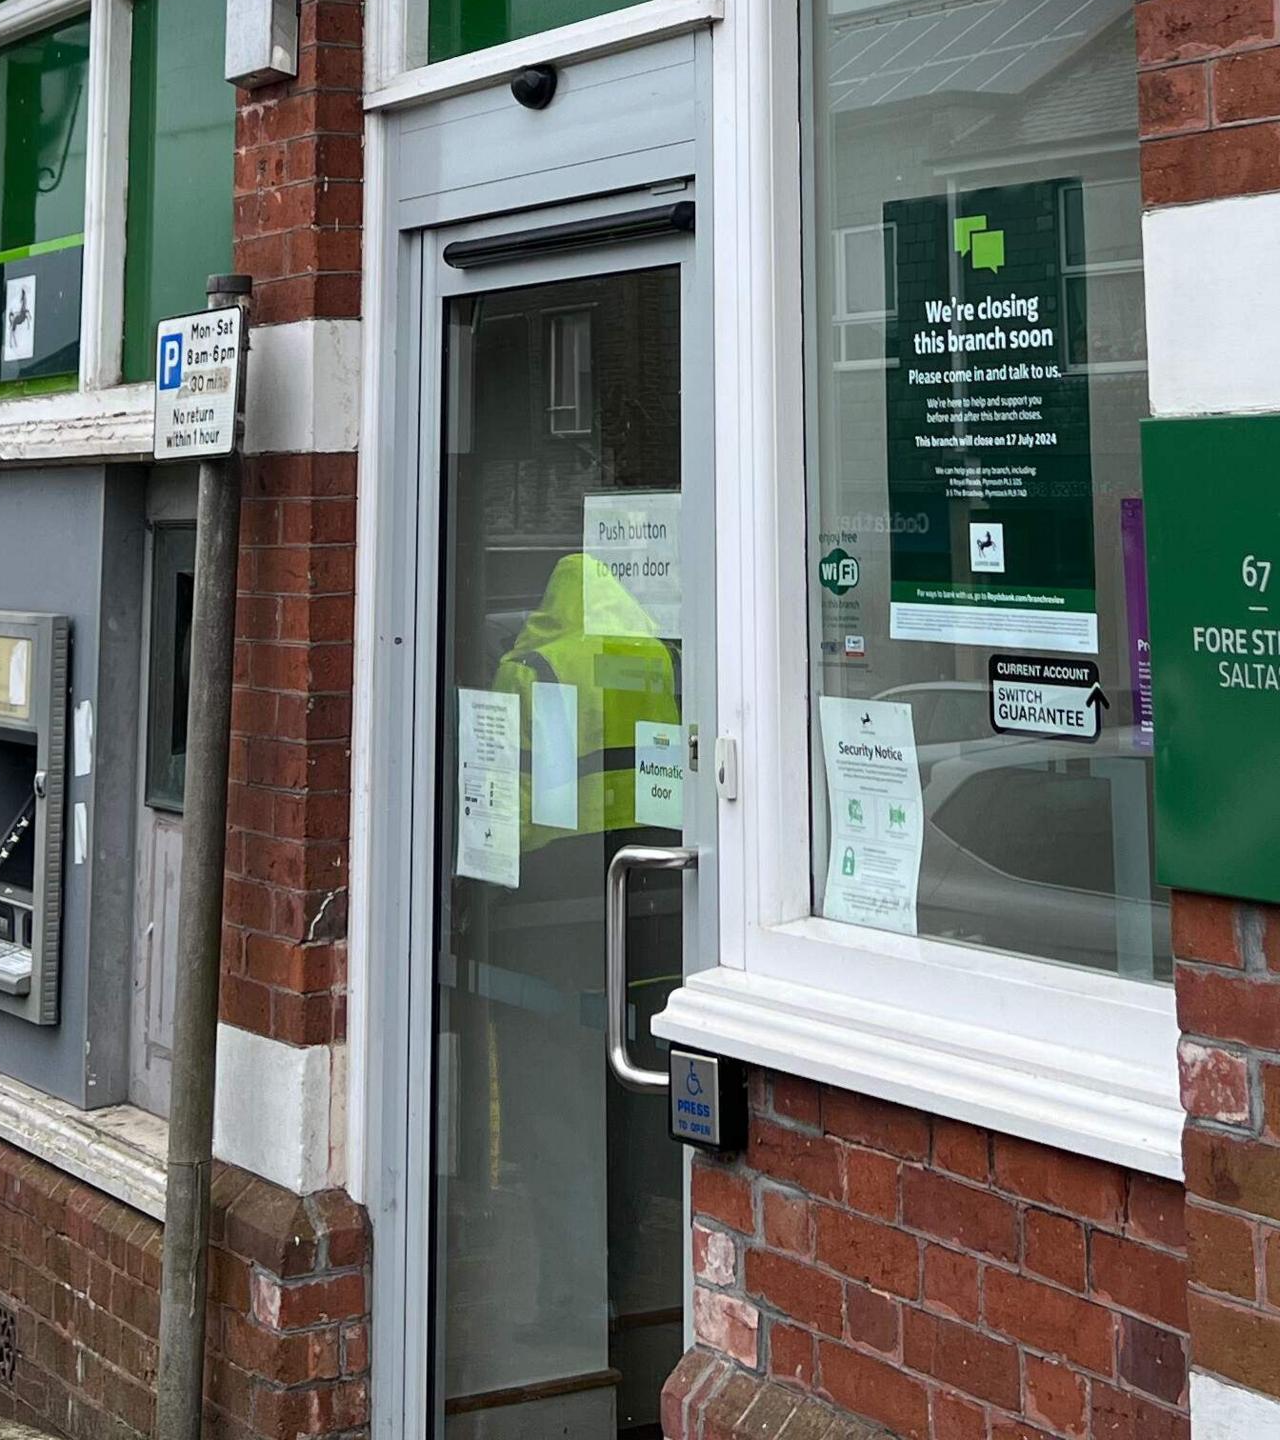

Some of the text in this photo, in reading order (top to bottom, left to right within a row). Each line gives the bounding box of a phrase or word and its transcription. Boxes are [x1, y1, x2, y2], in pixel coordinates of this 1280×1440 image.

[925, 293, 1038, 323] We're closing
[914, 326, 1053, 354] this branch soon
[909, 363, 1061, 384] Please come in and talk to us.
[191, 376, 202, 392] 30
[947, 398, 962, 408] here
[963, 398, 970, 407] to
[971, 397, 986, 408] help
[987, 396, 1000, 406] and
[1001, 396, 1027, 407] support
[1029, 396, 1042, 407] you
[173, 407, 213, 424] No return
[927, 413, 949, 423] before
[950, 412, 962, 422] and
[964, 411, 980, 422] after
[981, 411, 993, 421] this
[994, 410, 1018, 421] branch
[167, 428, 219, 448] within 1 hour
[915, 433, 1057, 447] This branch will close on 17 July 2024
[600, 520, 667, 540] Push button
[842, 530, 857, 543] free
[597, 556, 670, 582] to open door
[1242, 555, 1271, 592] 67
[1193, 627, 1248, 654] FORE
[997, 662, 1090, 680] CURRENT ACCOUNT
[998, 687, 1042, 704] SWITCH
[999, 703, 1084, 727] GUARANTEE
[838, 741, 902, 761] Security Notice
[640, 760, 683, 780] Automatic
[651, 784, 672, 800] door
[677, 1099, 710, 1117] PRESS
[678, 1120, 711, 1136] TO OPEN
